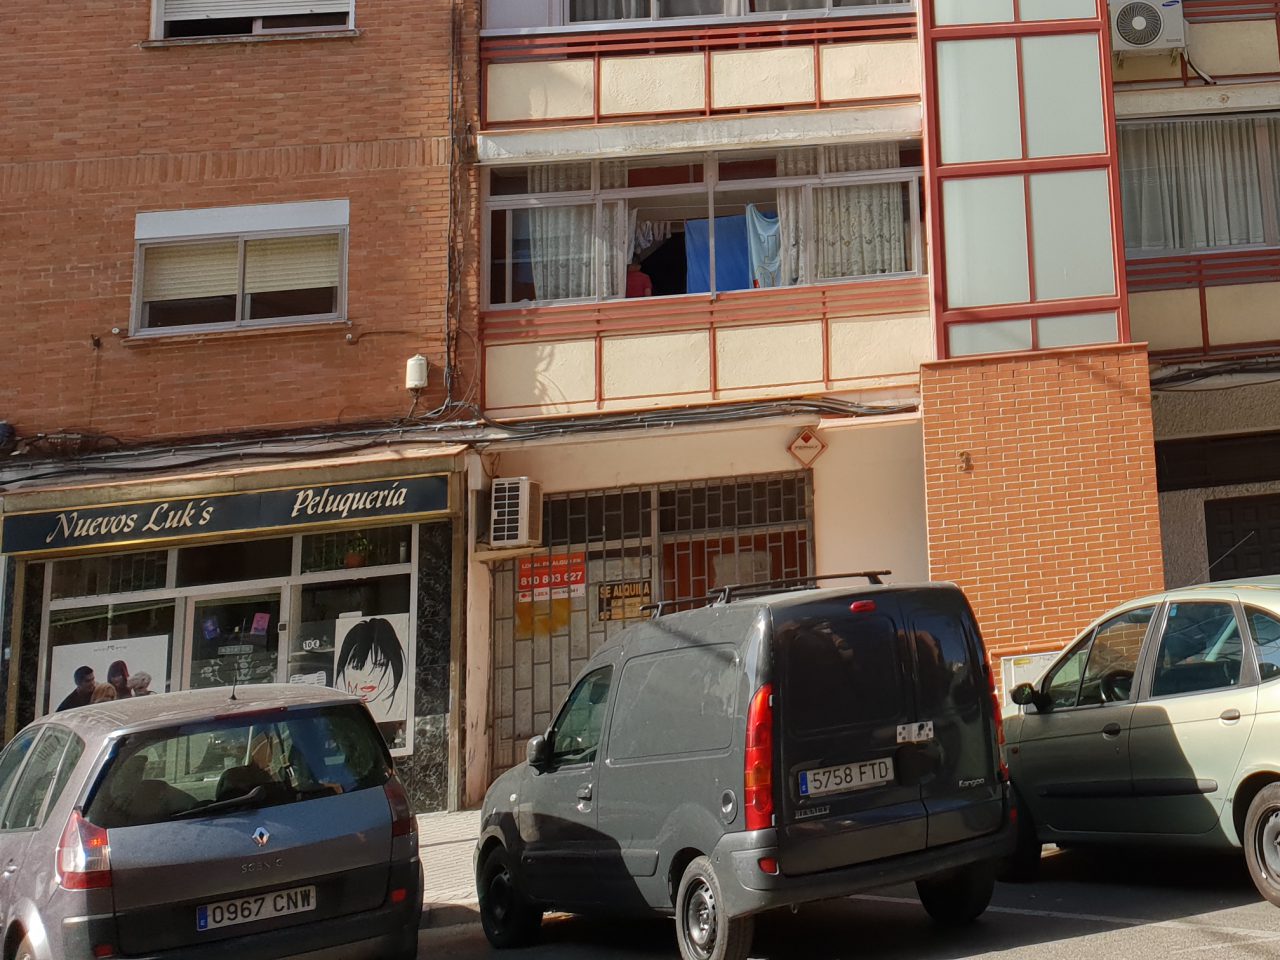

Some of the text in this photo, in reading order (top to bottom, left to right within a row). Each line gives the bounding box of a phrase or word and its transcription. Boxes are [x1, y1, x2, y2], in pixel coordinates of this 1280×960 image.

[291, 481, 408, 520] Peluquería
[45, 511, 135, 544] Nuevos
[600, 586, 611, 598] SE
[813, 761, 888, 790] 5758 FTD
[212, 889, 311, 924] 0967 CNW
